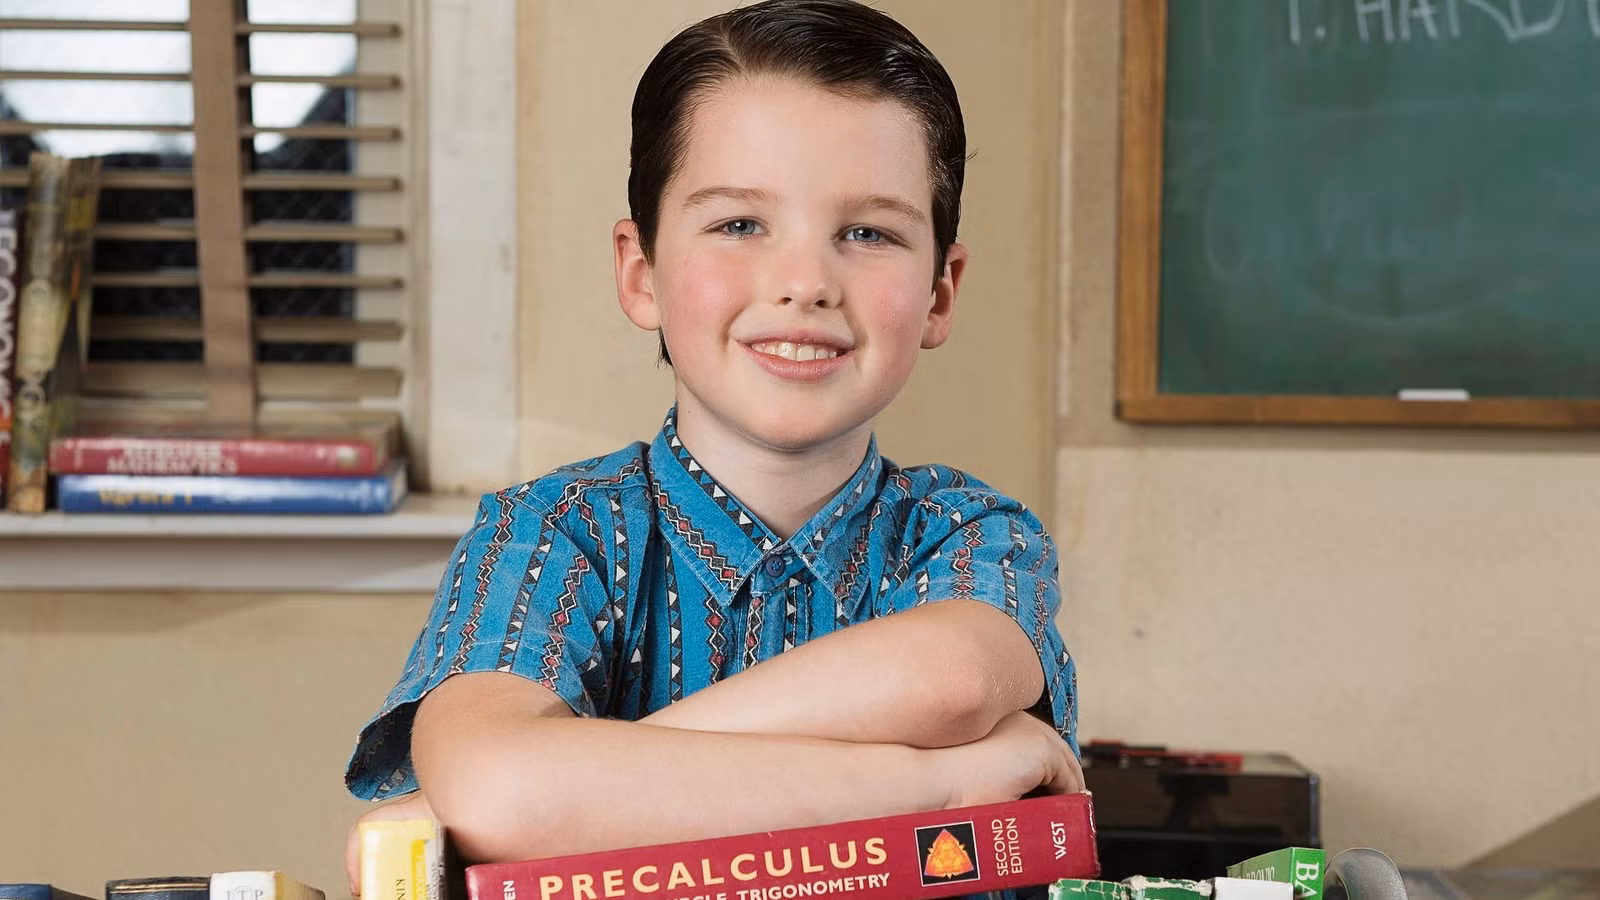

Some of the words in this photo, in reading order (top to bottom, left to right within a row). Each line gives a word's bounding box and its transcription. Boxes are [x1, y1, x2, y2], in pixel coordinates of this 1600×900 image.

[1354, 0, 1600, 43] HARD
[991, 819, 1009, 876] SECOND
[1006, 817, 1023, 875] EDITION
[1050, 820, 1067, 861] WEST
[539, 837, 889, 900] PRECALCULUS
[736, 872, 890, 900] TRIGONOMETRY
